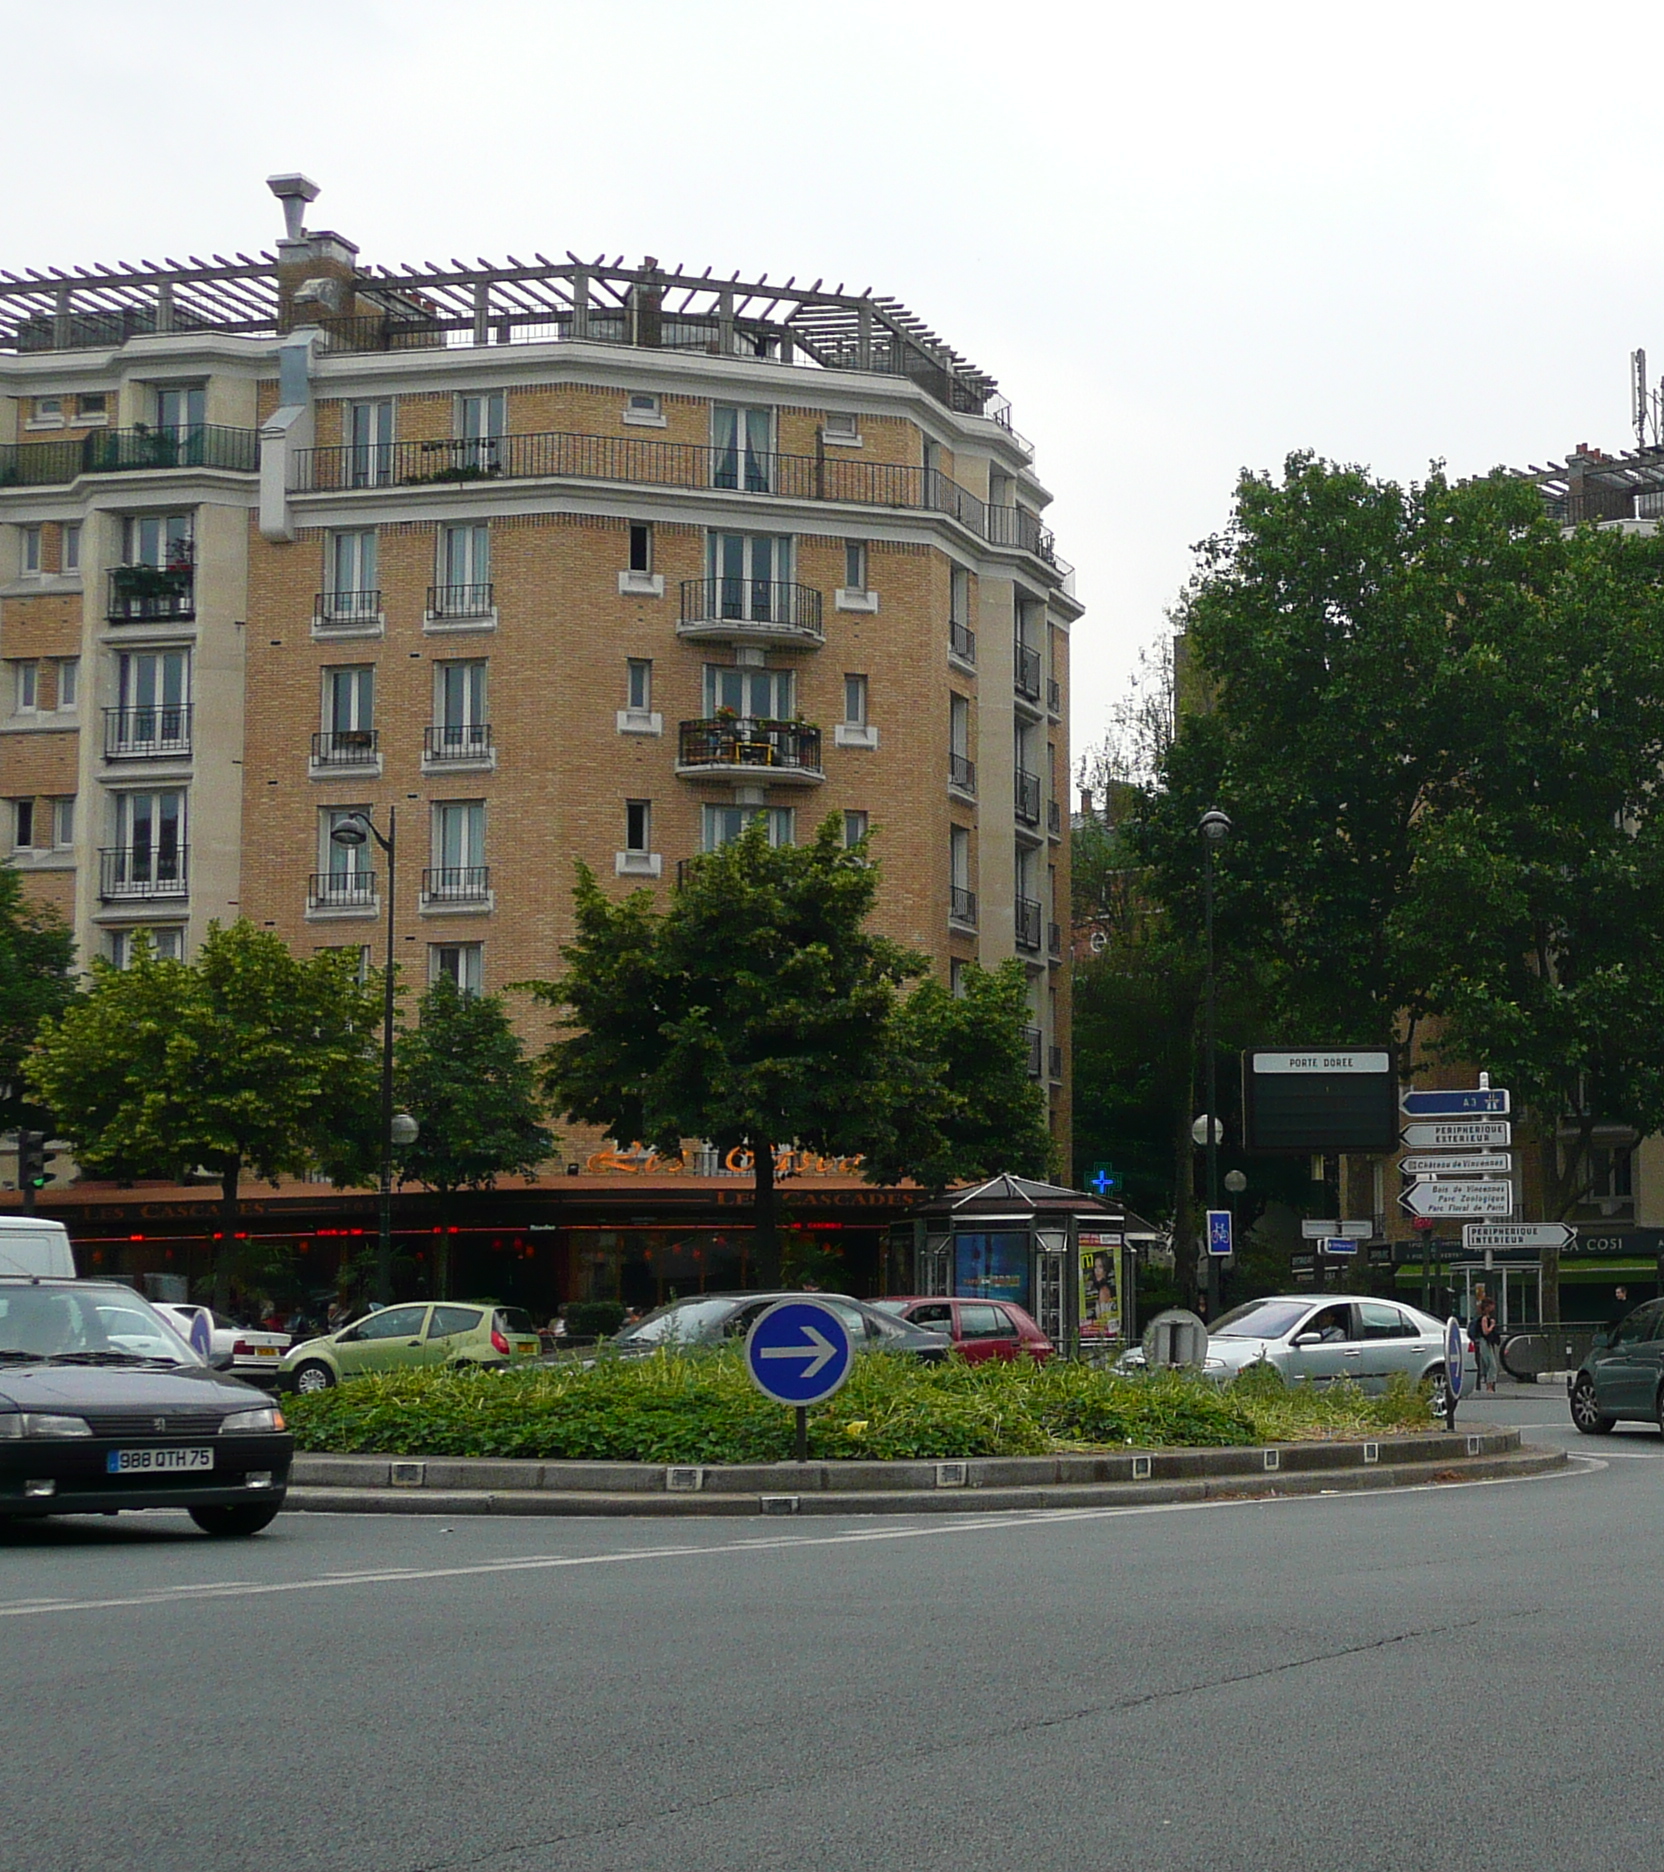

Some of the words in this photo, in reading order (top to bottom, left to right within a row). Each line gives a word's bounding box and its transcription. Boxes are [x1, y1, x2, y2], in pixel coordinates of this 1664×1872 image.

[1289, 1058, 1318, 1068] PORTE
[1323, 1057, 1354, 1068] DOREE
[1435, 1125, 1504, 1134] PERIPHERIQUE
[1435, 1134, 1490, 1143] EXTERIEUR
[1463, 1159, 1504, 1168] Vincennes
[1466, 1184, 1505, 1193] Vincennes
[1438, 1194, 1456, 1203] Parc
[1460, 1194, 1505, 1204] Zoologique
[140, 1203, 266, 1219] CASCAES
[1428, 1204, 1444, 1212] Parc
[1473, 1204, 1482, 1212] de
[1486, 1203, 1505, 1212] Paris
[1471, 1227, 1539, 1235] PERIPHERIQUE
[1471, 1236, 1524, 1244] INTERIEUR
[1586, 1239, 1623, 1251] COSI
[120, 1453, 152, 1469] 988
[156, 1451, 186, 1467] QTH
[190, 1450, 210, 1466] 75
